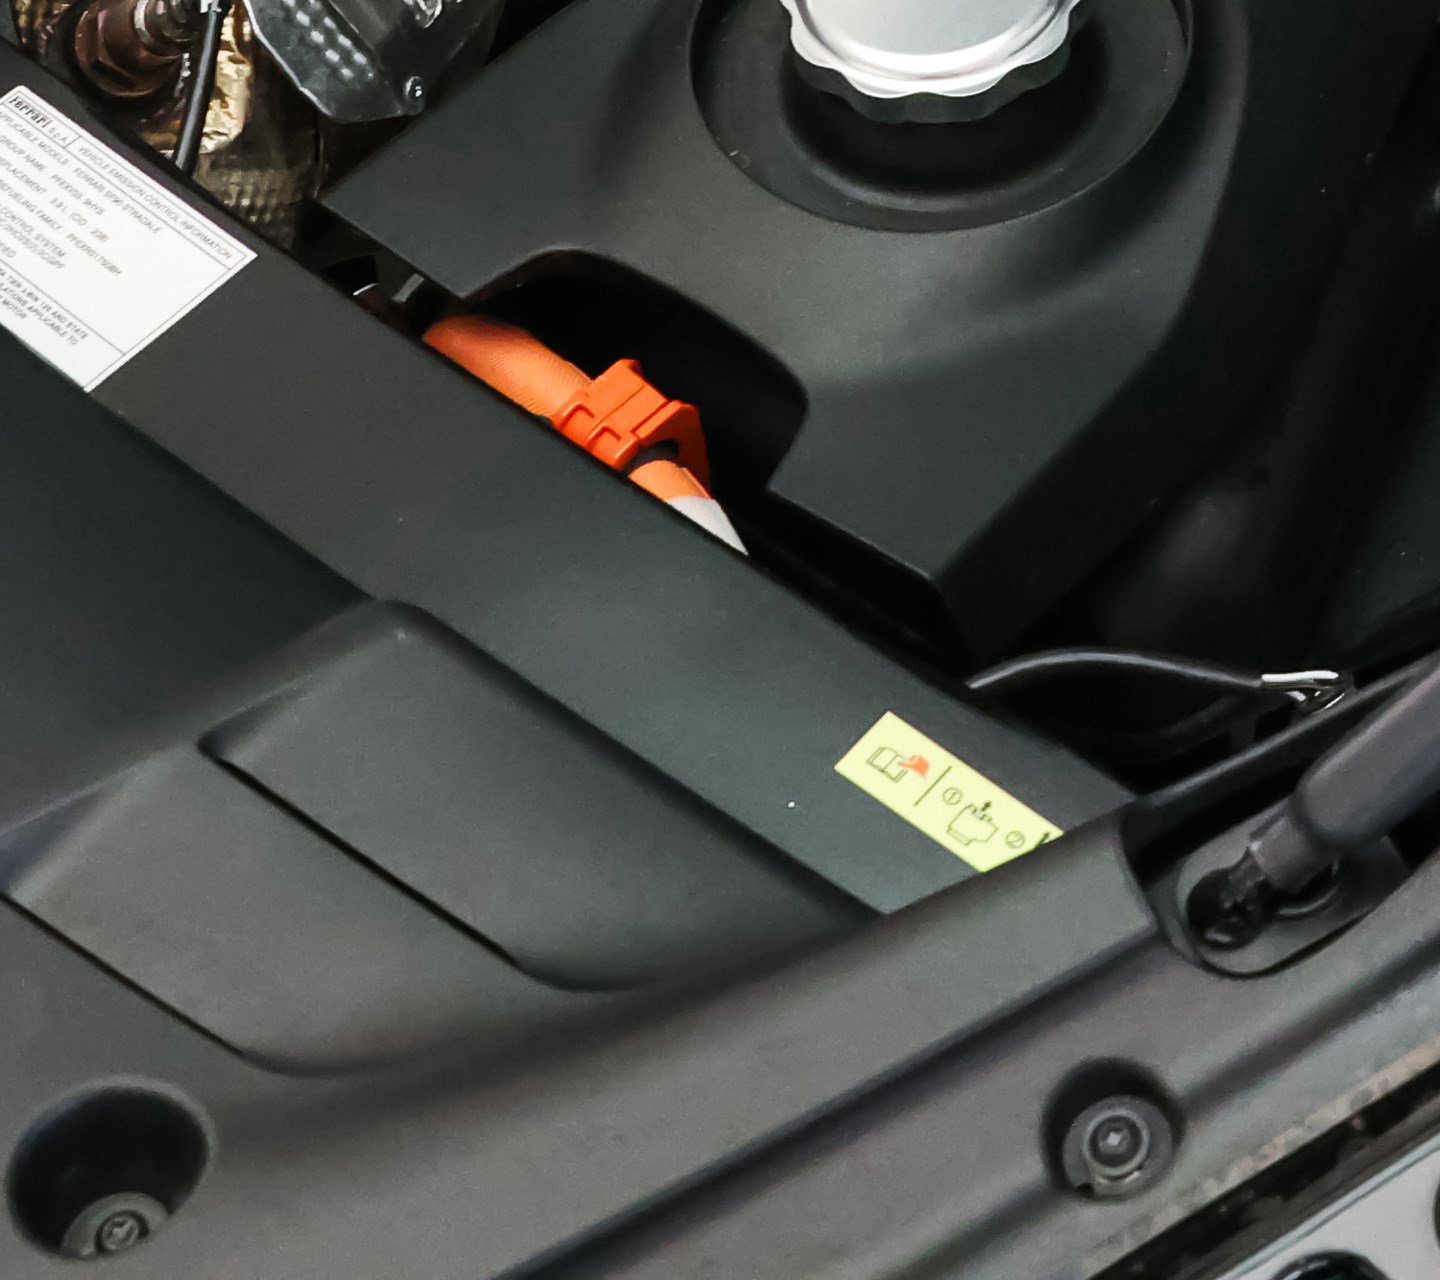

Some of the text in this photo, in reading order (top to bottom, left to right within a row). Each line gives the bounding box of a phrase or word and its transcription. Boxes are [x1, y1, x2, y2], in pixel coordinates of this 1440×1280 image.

[7, 95, 53, 128] Ferrari
[22, 153, 47, 172] NAME
[72, 166, 106, 192] FERRARI
[120, 202, 163, 234] STRADALE
[76, 145, 233, 260] VEHICLE EMISSION CONTROL INFORMATION
[34, 209, 64, 232] FAMILY
[33, 233, 66, 258] SYSTEM
[25, 304, 68, 337] APPLICABLE
[64, 320, 89, 339] STATE
